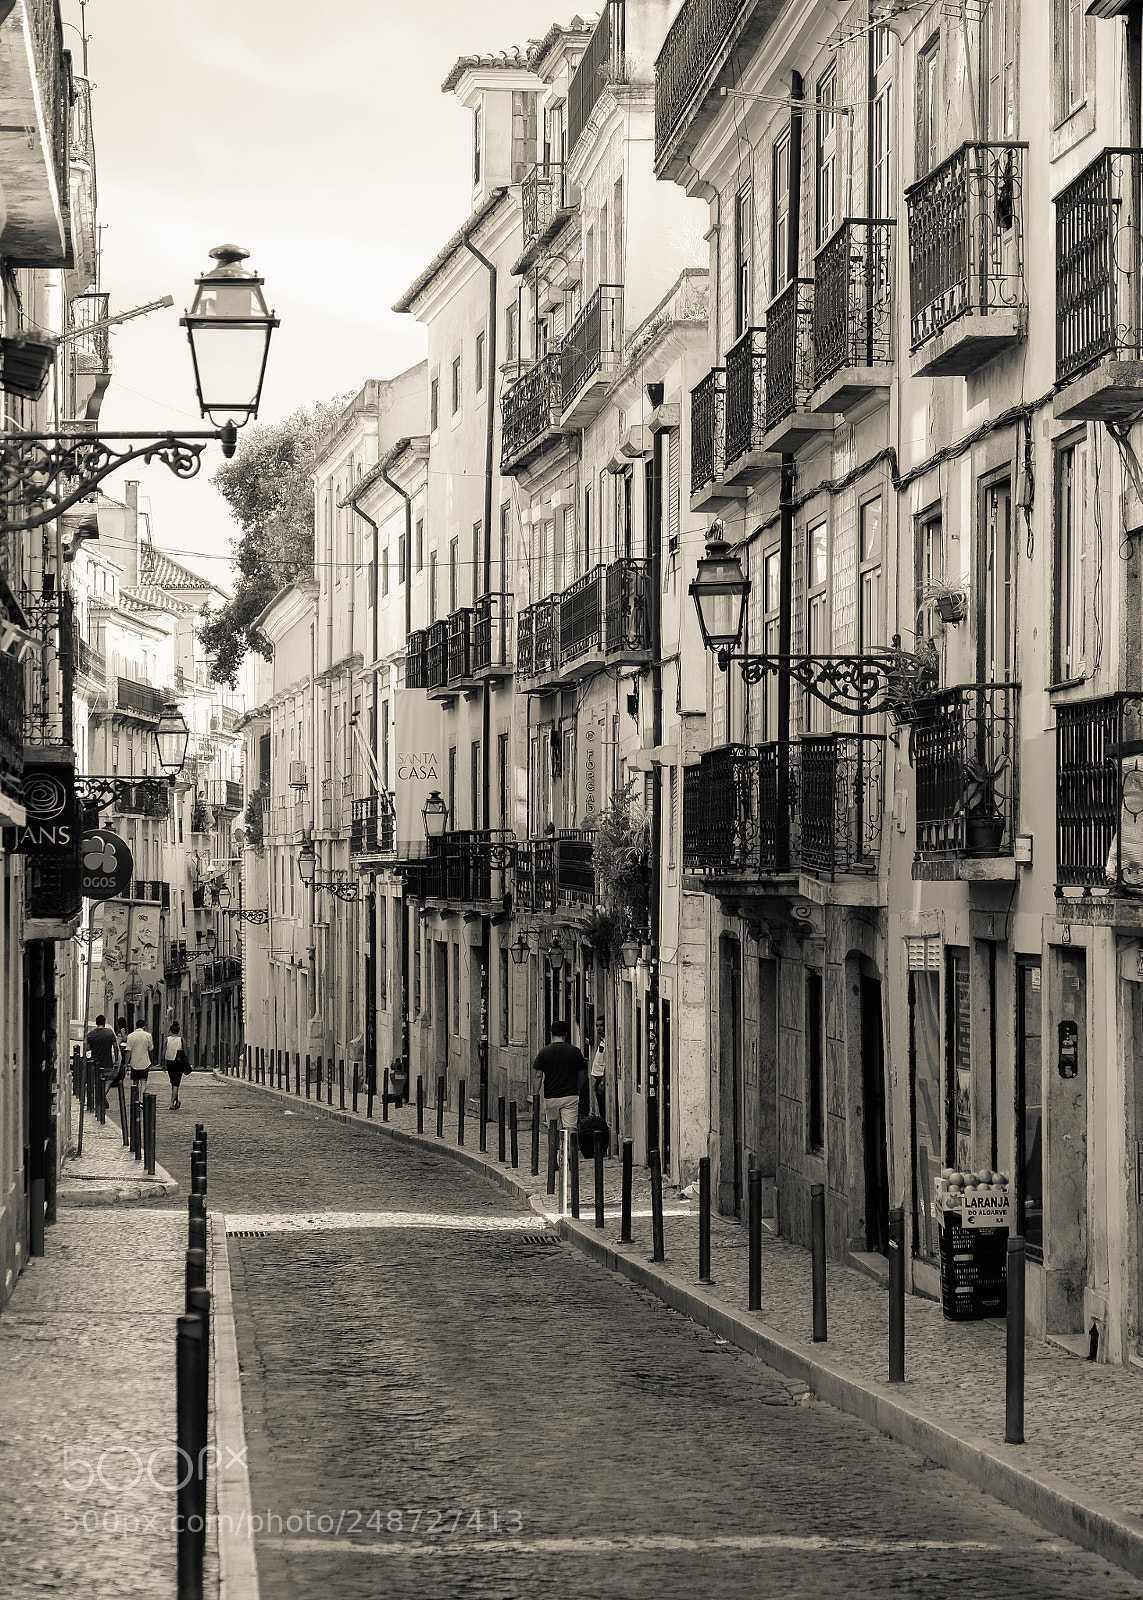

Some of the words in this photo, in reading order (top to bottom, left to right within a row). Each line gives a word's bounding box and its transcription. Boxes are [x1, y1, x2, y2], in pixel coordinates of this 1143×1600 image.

[397, 752, 438, 765] SANTA
[397, 766, 438, 780] CASA
[12, 825, 70, 851] JANS
[82, 876, 116, 888] OGOS
[964, 1196, 1010, 1208] LARANJA
[967, 1216, 976, 1224] €
